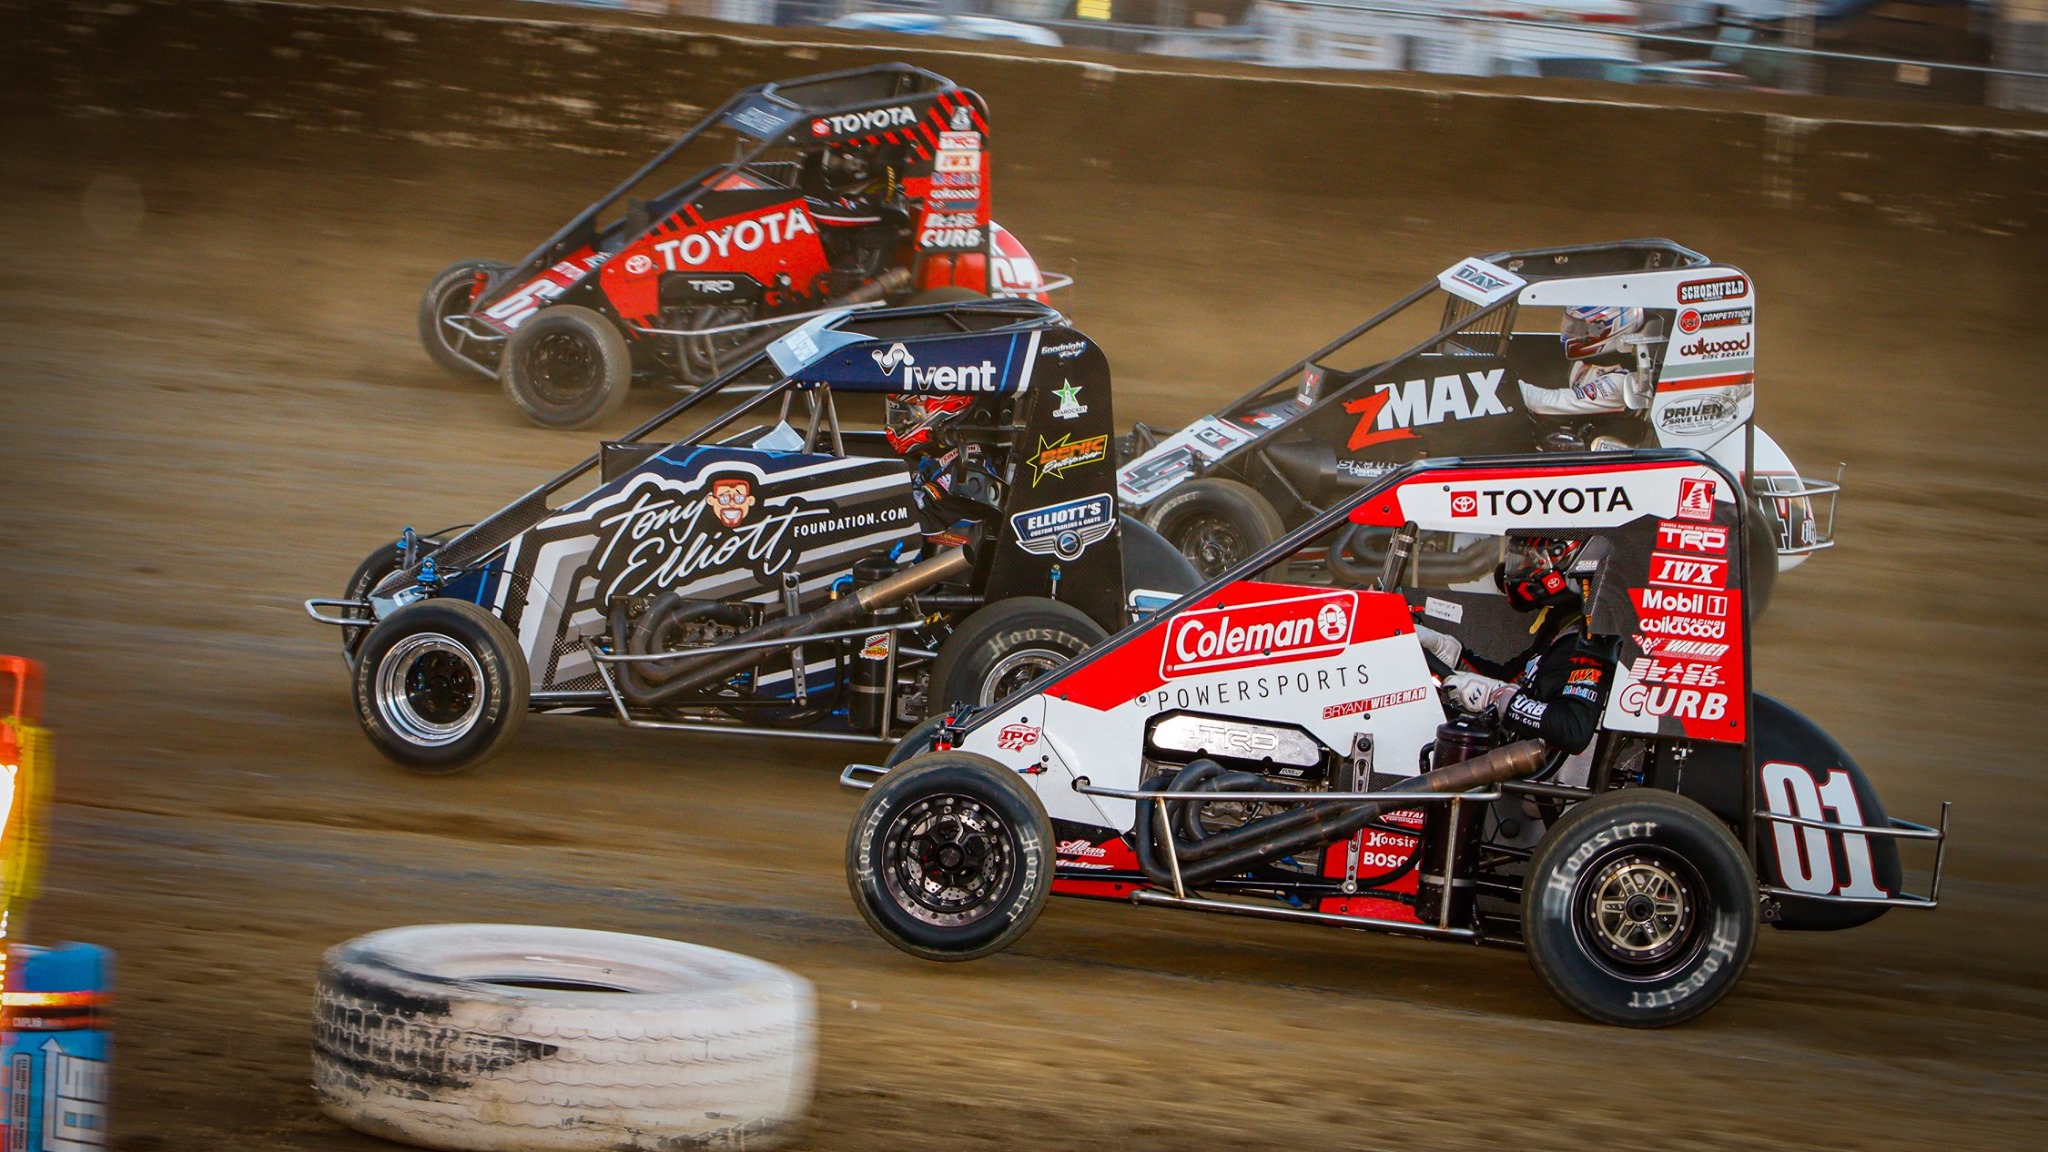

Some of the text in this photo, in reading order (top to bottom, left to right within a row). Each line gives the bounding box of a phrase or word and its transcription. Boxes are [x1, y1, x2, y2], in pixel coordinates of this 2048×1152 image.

[829, 106, 917, 134] TOYOTA
[654, 207, 815, 271] TOYOTA
[920, 228, 982, 247] CURB
[688, 280, 734, 293] TRD
[1453, 265, 1507, 291] DAY
[1681, 280, 1744, 300] SCHOENFELD
[1702, 309, 1750, 322] COMPETITION
[1041, 341, 1087, 355] Goodnight
[1680, 332, 1750, 357] wilwood
[1664, 398, 1724, 421] DRIVEN
[1482, 486, 1634, 516] TOYOTA
[793, 507, 908, 538] FOUNDATION.COM
[1027, 502, 1102, 530] ELLIOTT'S
[597, 492, 714, 572] Tony
[1030, 527, 1053, 537] CUSTOM
[1659, 527, 1726, 550] TRD
[603, 506, 830, 607] Elliott
[1658, 560, 1718, 585] IWX
[1641, 588, 1704, 614] Mobil
[1176, 616, 1314, 662] Coleman
[1639, 615, 1725, 639] wilwood
[1664, 639, 1730, 657] WALKER
[1157, 664, 1370, 711] POWERSPORTS
[1620, 683, 1728, 721] CURB
[1001, 731, 1037, 743] IPC
[1199, 725, 1277, 752] TRD
[1760, 760, 1892, 899] 01
[1547, 821, 1658, 892] Hoosier
[1628, 929, 1738, 1009] Hoosier
